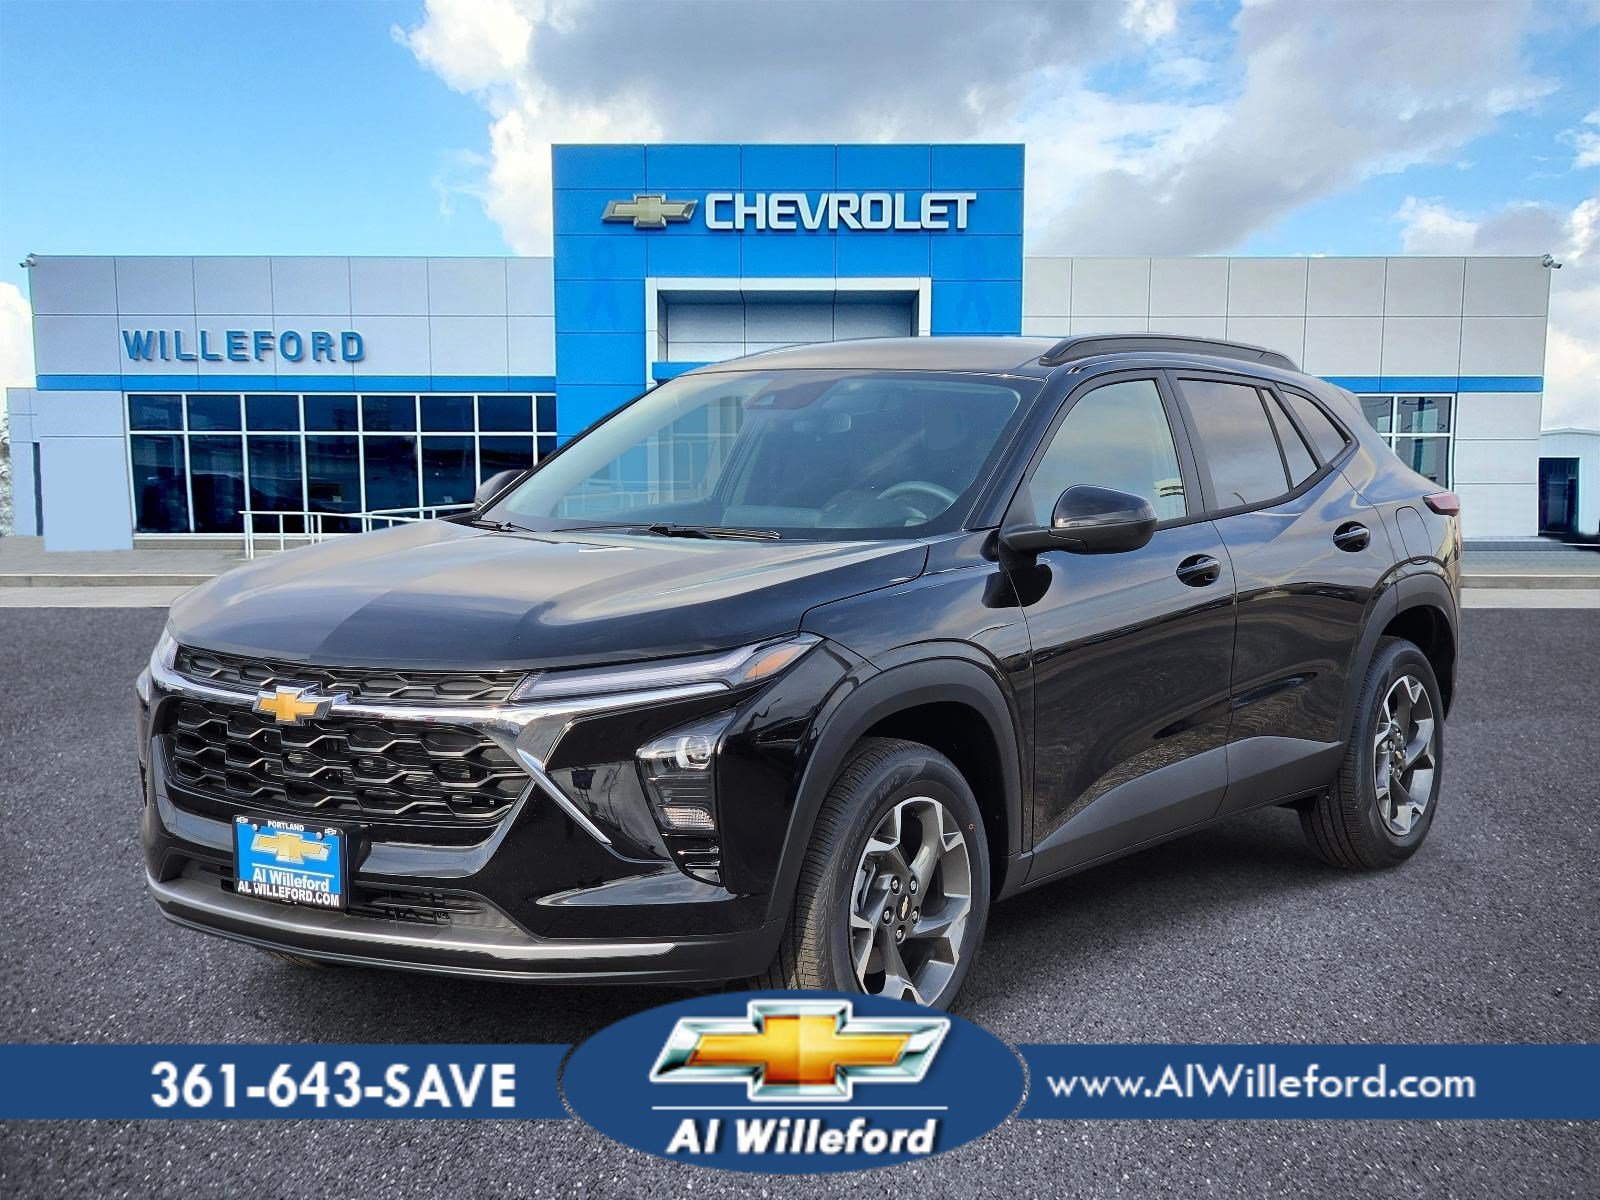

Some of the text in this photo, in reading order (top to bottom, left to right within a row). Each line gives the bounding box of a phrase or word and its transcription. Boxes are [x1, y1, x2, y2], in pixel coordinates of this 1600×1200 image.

[705, 192, 977, 230] CHEVROLET
[122, 330, 365, 362] WILLEFORD
[267, 820, 304, 832] PORTLAND
[237, 880, 339, 907] AL WILLEFORD.COM
[252, 868, 329, 892] Al Willeford
